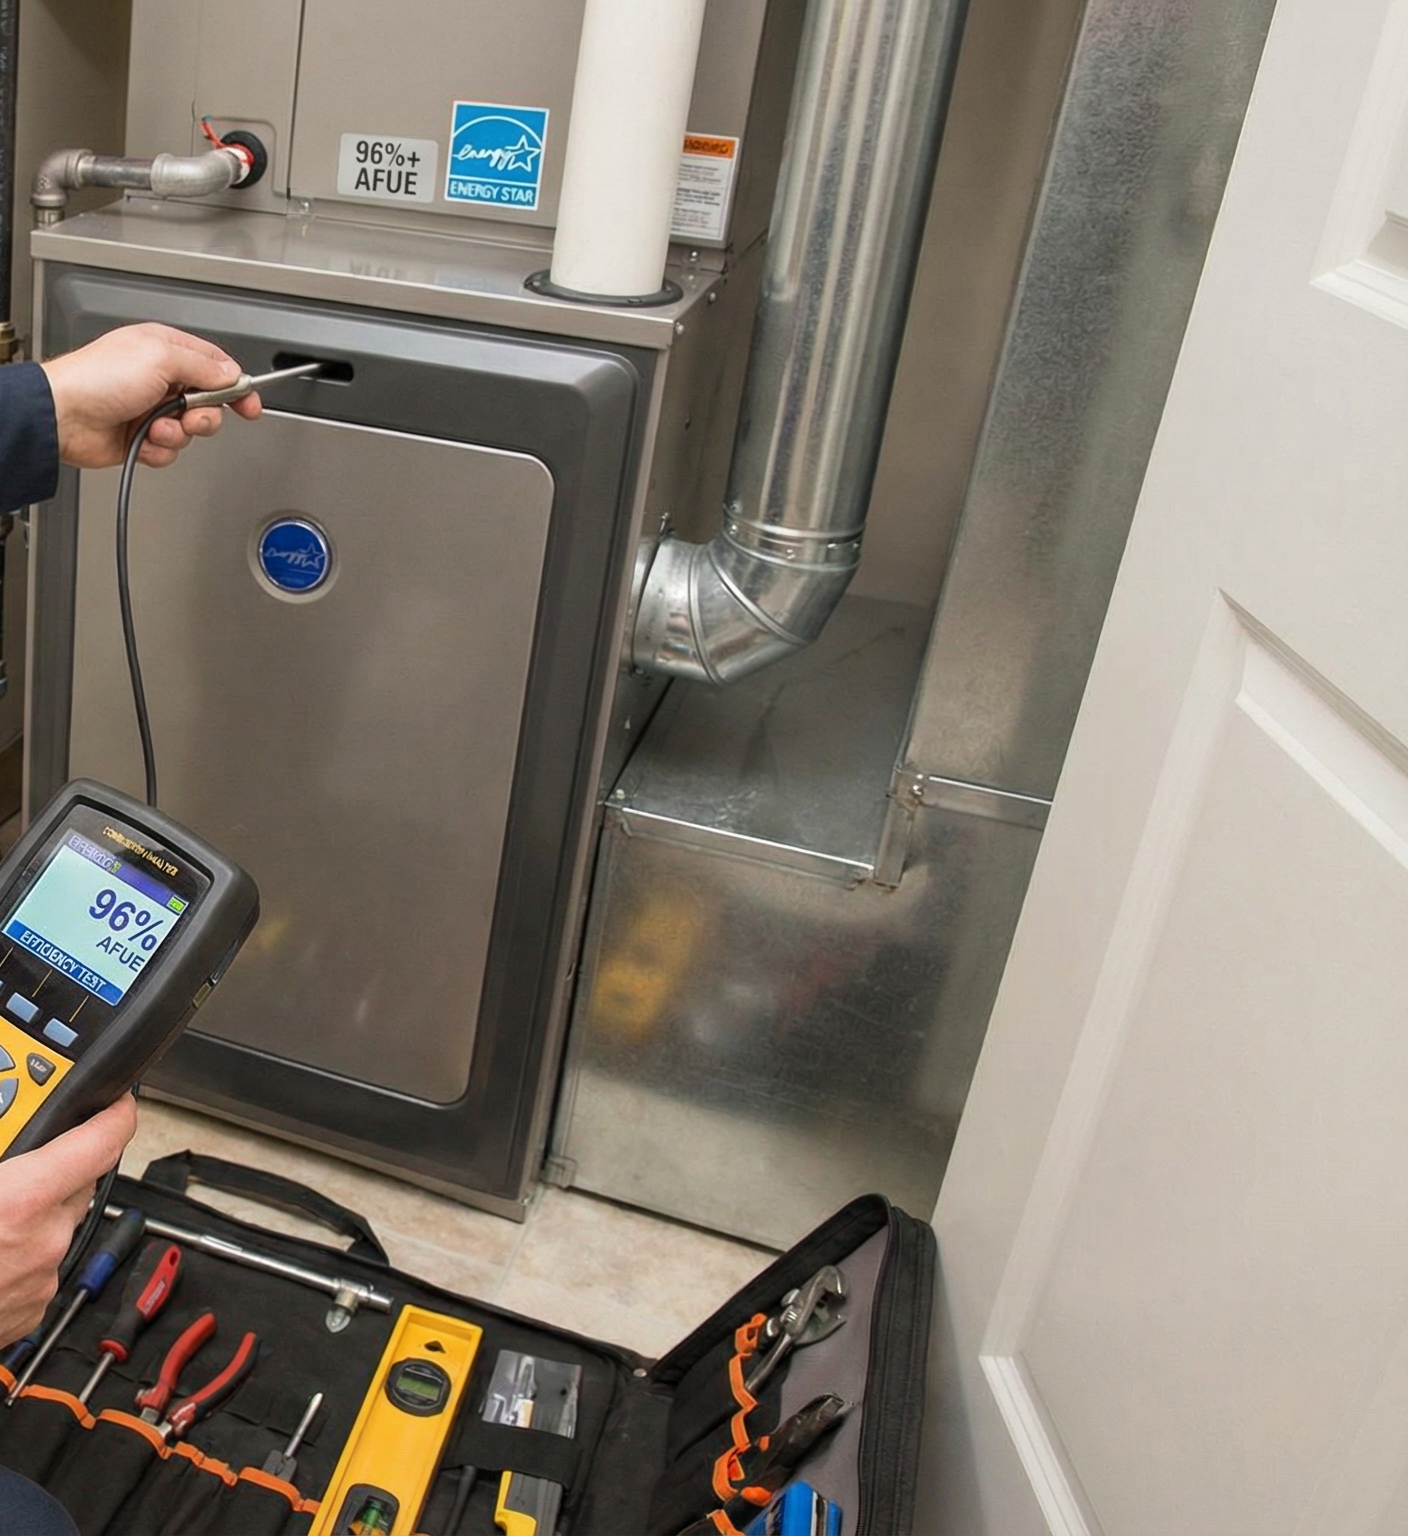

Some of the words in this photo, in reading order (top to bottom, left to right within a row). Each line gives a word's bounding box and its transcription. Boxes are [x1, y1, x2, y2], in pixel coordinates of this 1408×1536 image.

[356, 140, 421, 168] 96%+
[354, 167, 418, 196] AFUE
[450, 180, 500, 199] ENERGY
[500, 186, 534, 204] STAR
[88, 888, 164, 951] 96%
[95, 935, 146, 973] AFUE
[76, 965, 106, 992] TEST
